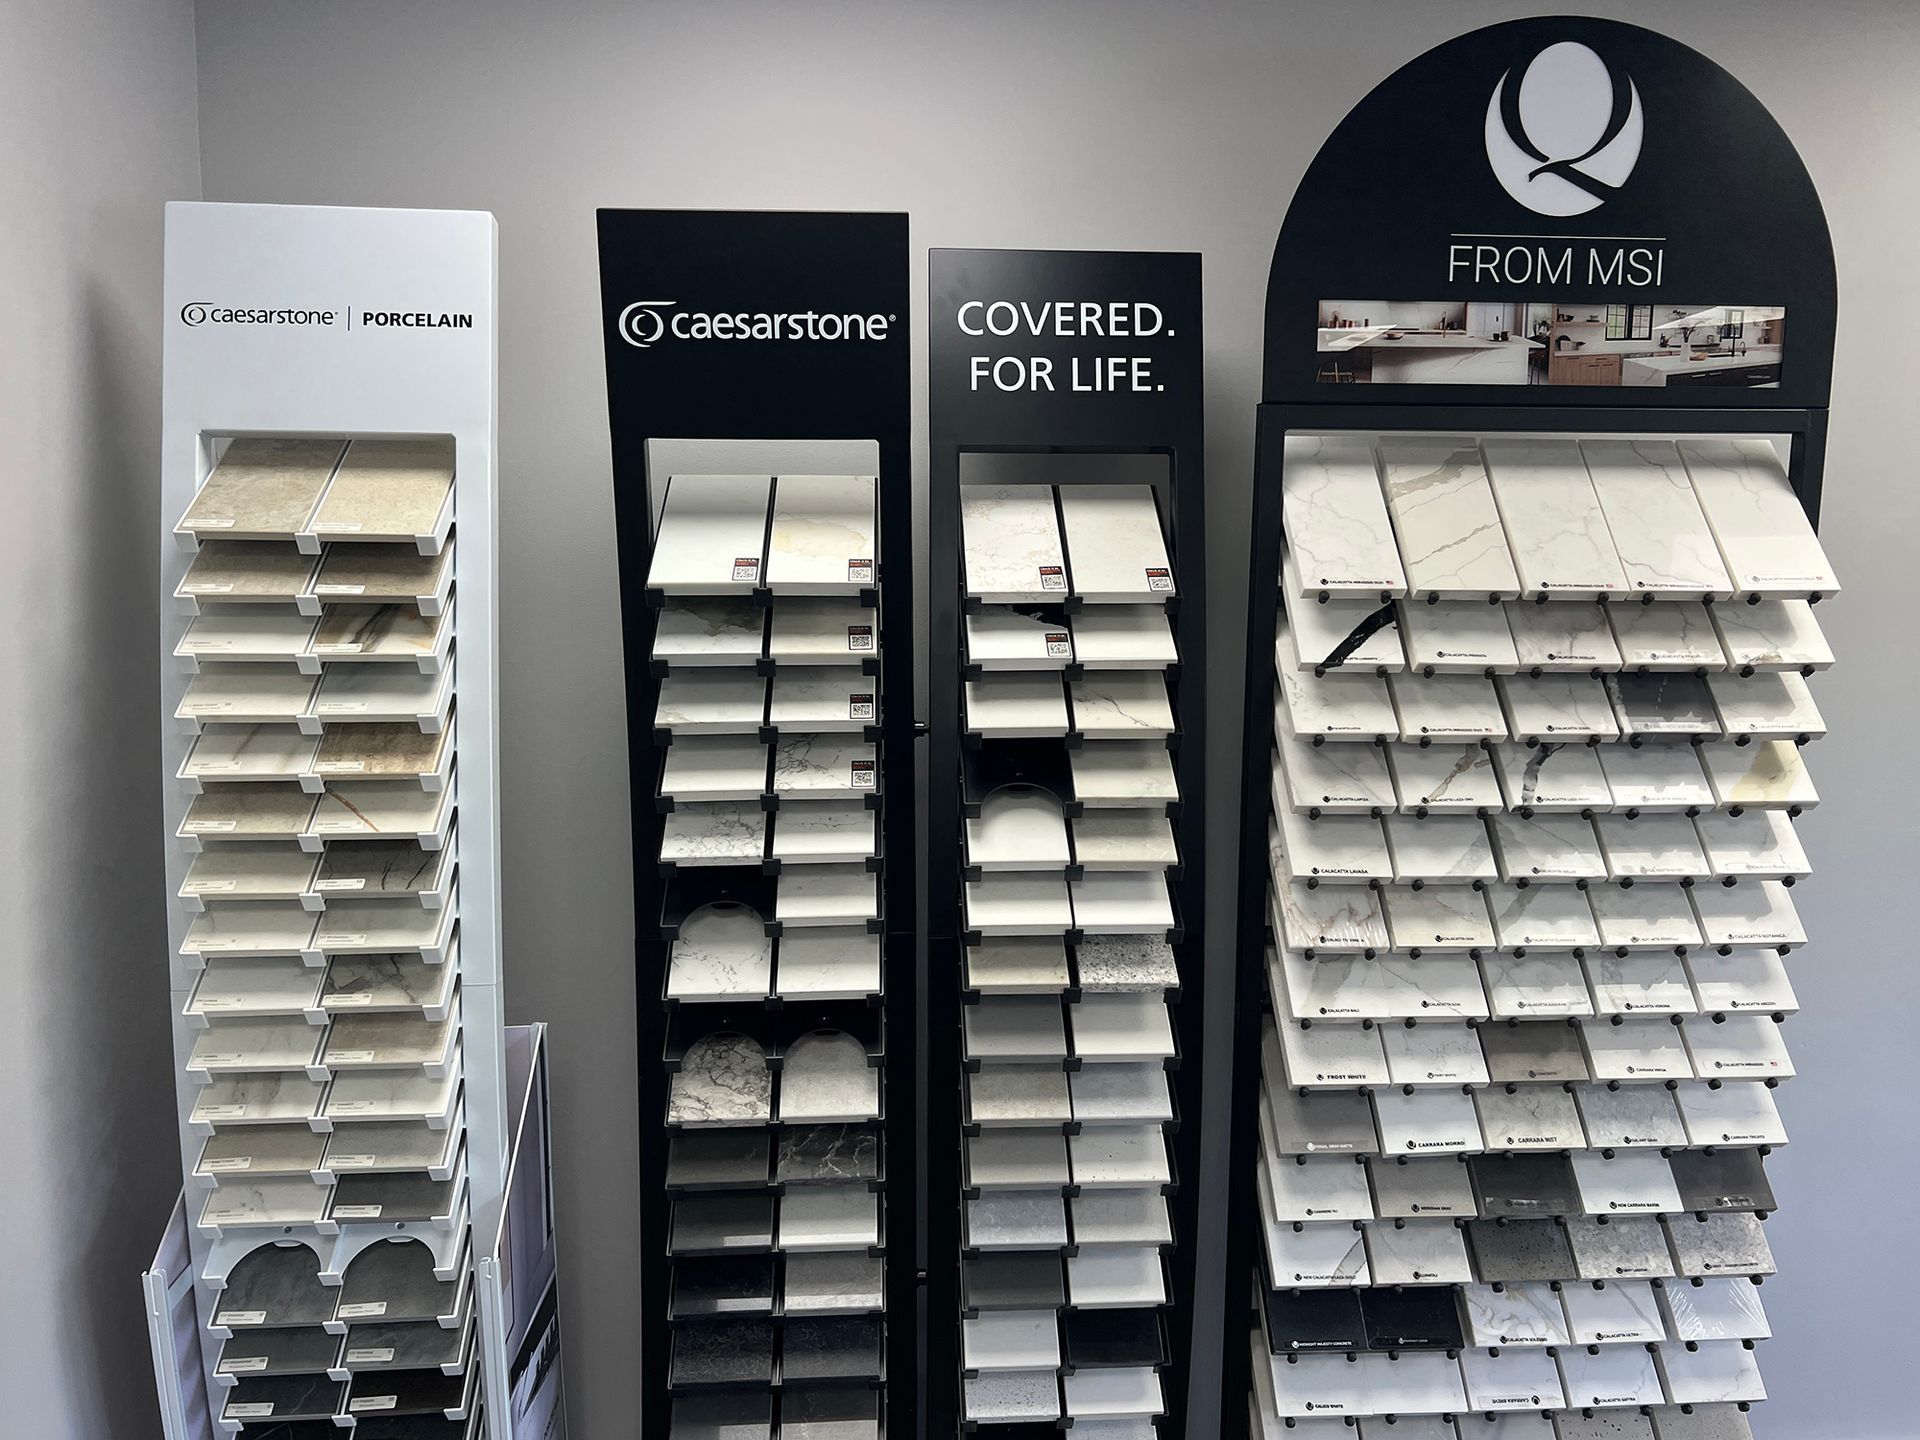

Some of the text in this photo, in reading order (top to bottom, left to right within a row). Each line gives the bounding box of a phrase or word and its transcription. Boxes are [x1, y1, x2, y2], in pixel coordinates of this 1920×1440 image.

[1448, 244, 1665, 287] FROM MSI
[210, 306, 473, 329] caesarstone PORCELAIN
[670, 309, 889, 341] caesarstone
[956, 301, 1177, 338] COVERED.
[969, 356, 1165, 393] FOR LIFE.
